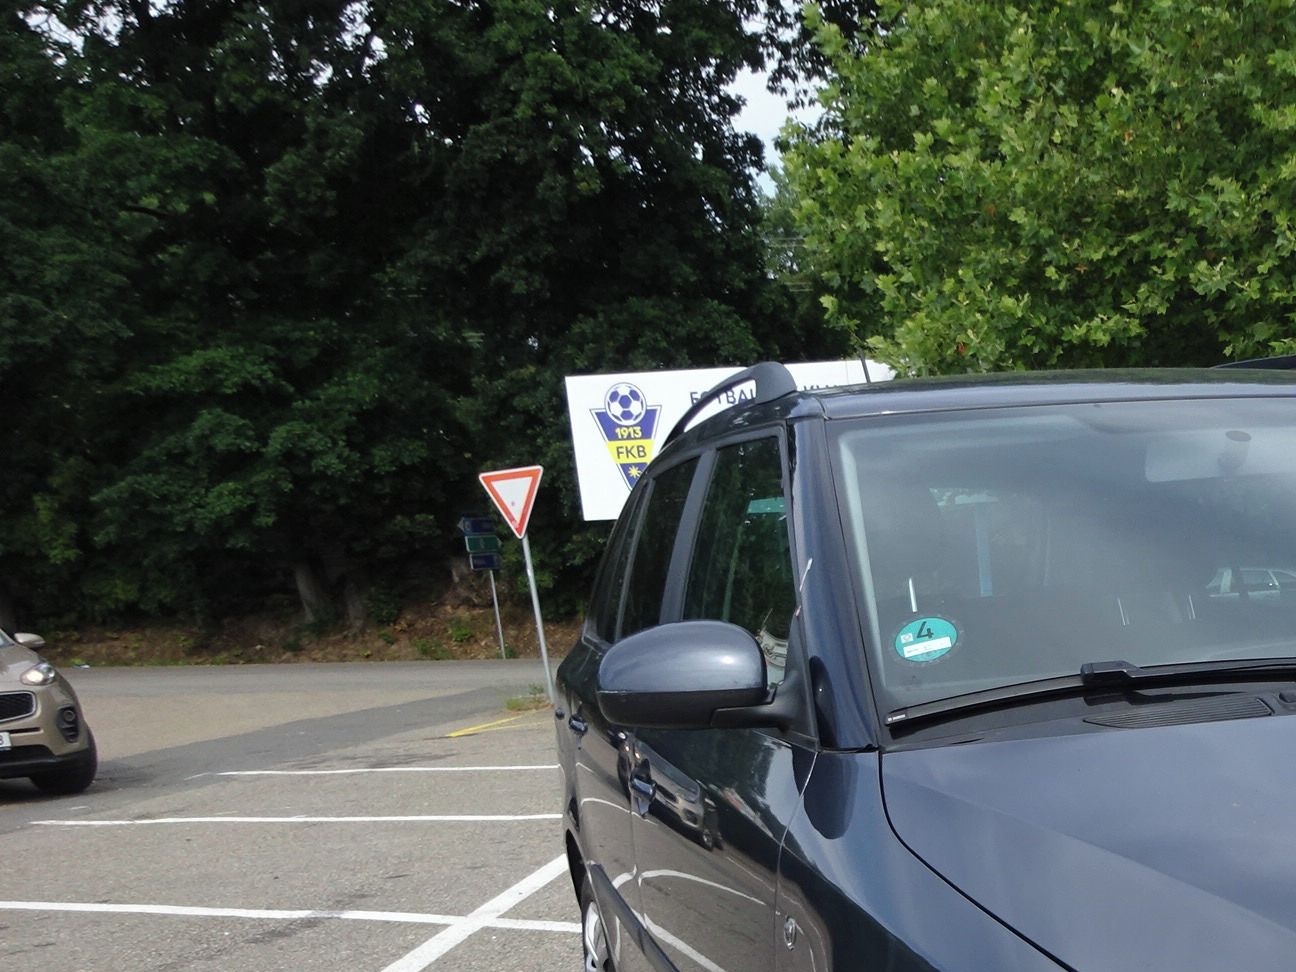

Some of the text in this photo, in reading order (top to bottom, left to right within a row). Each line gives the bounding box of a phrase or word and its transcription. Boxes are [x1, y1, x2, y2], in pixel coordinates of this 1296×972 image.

[615, 426, 642, 440] 1913
[616, 445, 647, 459] FKB
[916, 621, 934, 638] 4
